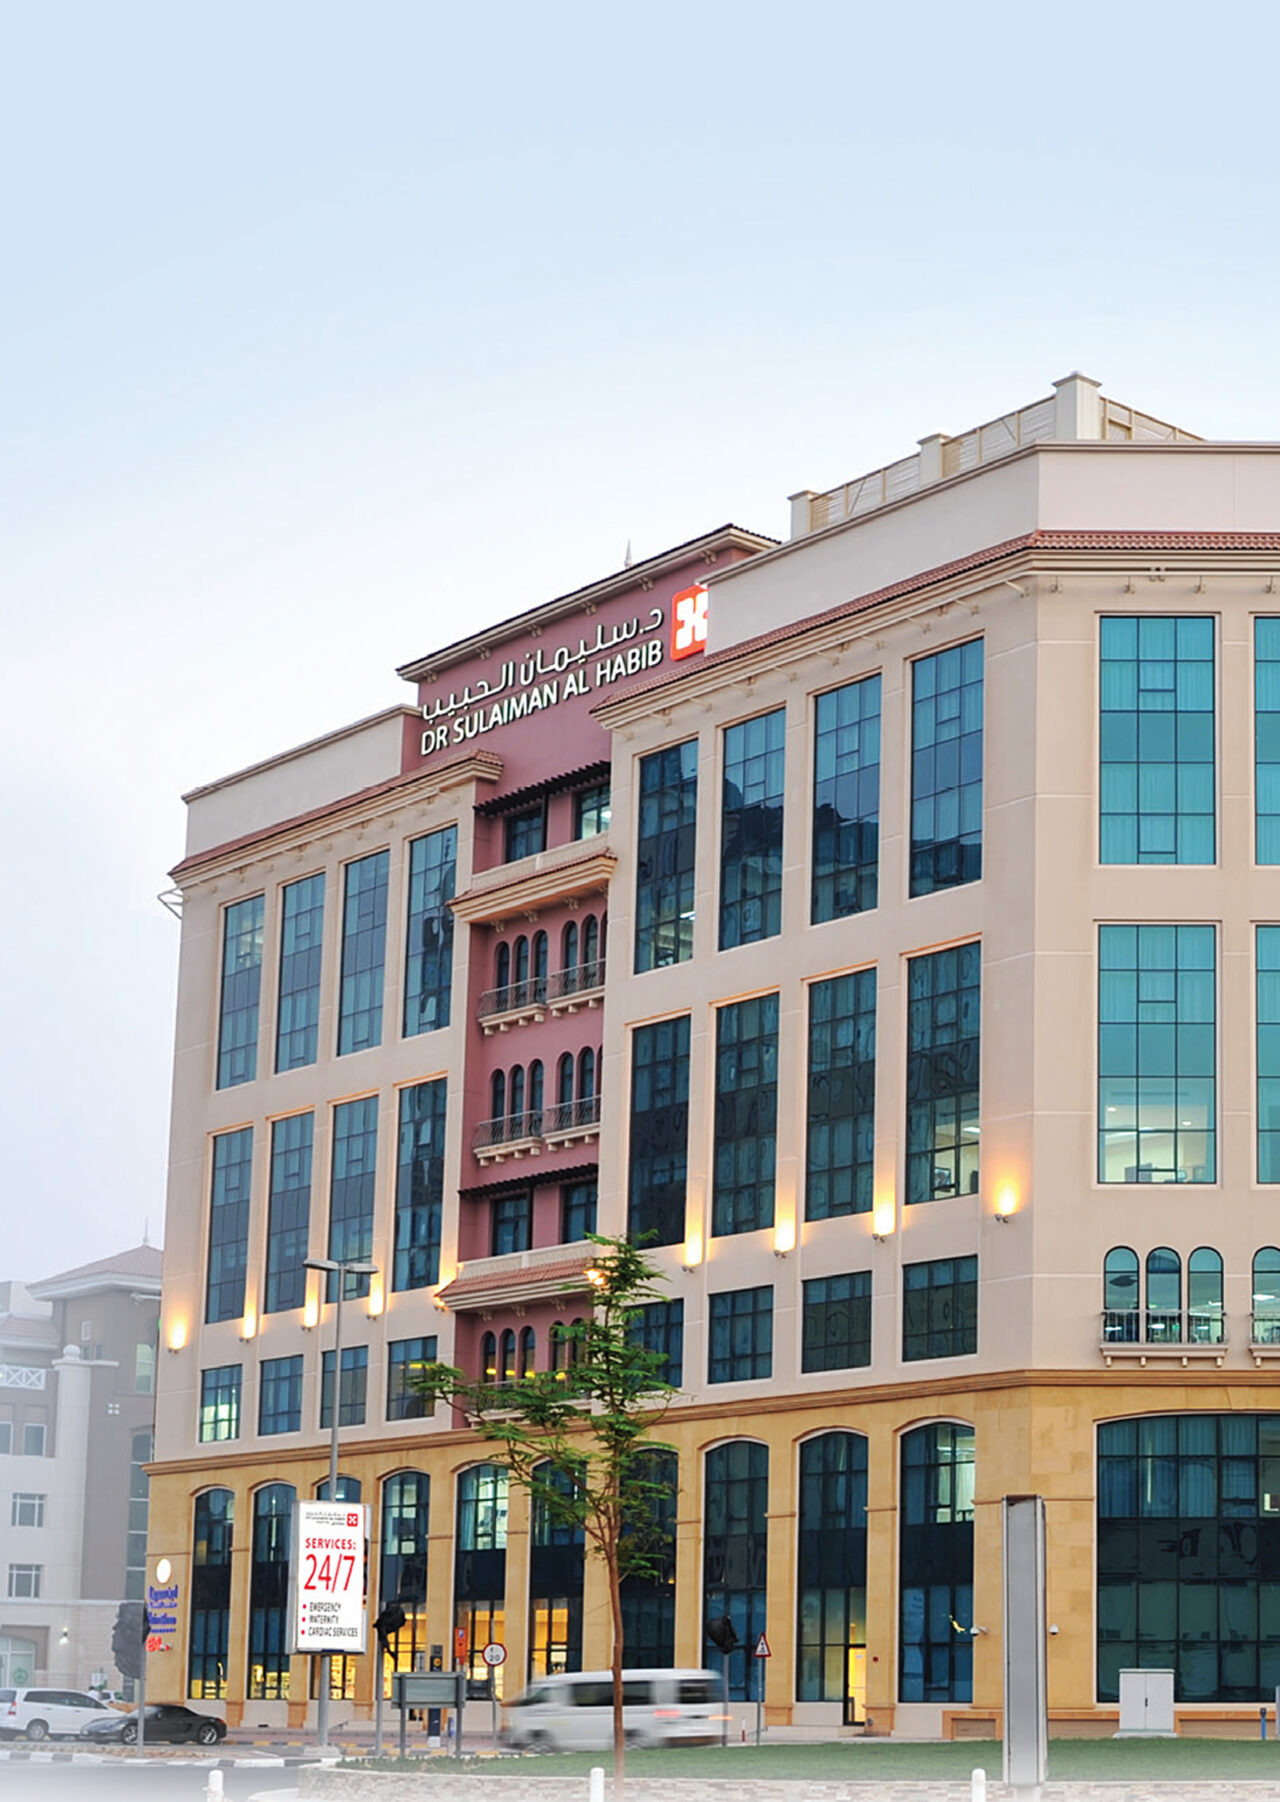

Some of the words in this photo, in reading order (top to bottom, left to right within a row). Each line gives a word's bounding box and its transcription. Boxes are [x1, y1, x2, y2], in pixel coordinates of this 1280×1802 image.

[420, 724, 449, 756] DR
[452, 680, 559, 744] SULAIMAN
[562, 673, 591, 701] AL
[595, 639, 663, 688] HABIB
[421, 660, 515, 725] الحبيب
[305, 1537, 357, 1550] SERVICES:
[304, 1553, 355, 1593] 24/7
[309, 1602, 341, 1612] EMERGENCY
[309, 1615, 339, 1624] MATERNITY
[308, 1627, 332, 1637] CARDIAC
[333, 1627, 358, 1638] SERVICES
